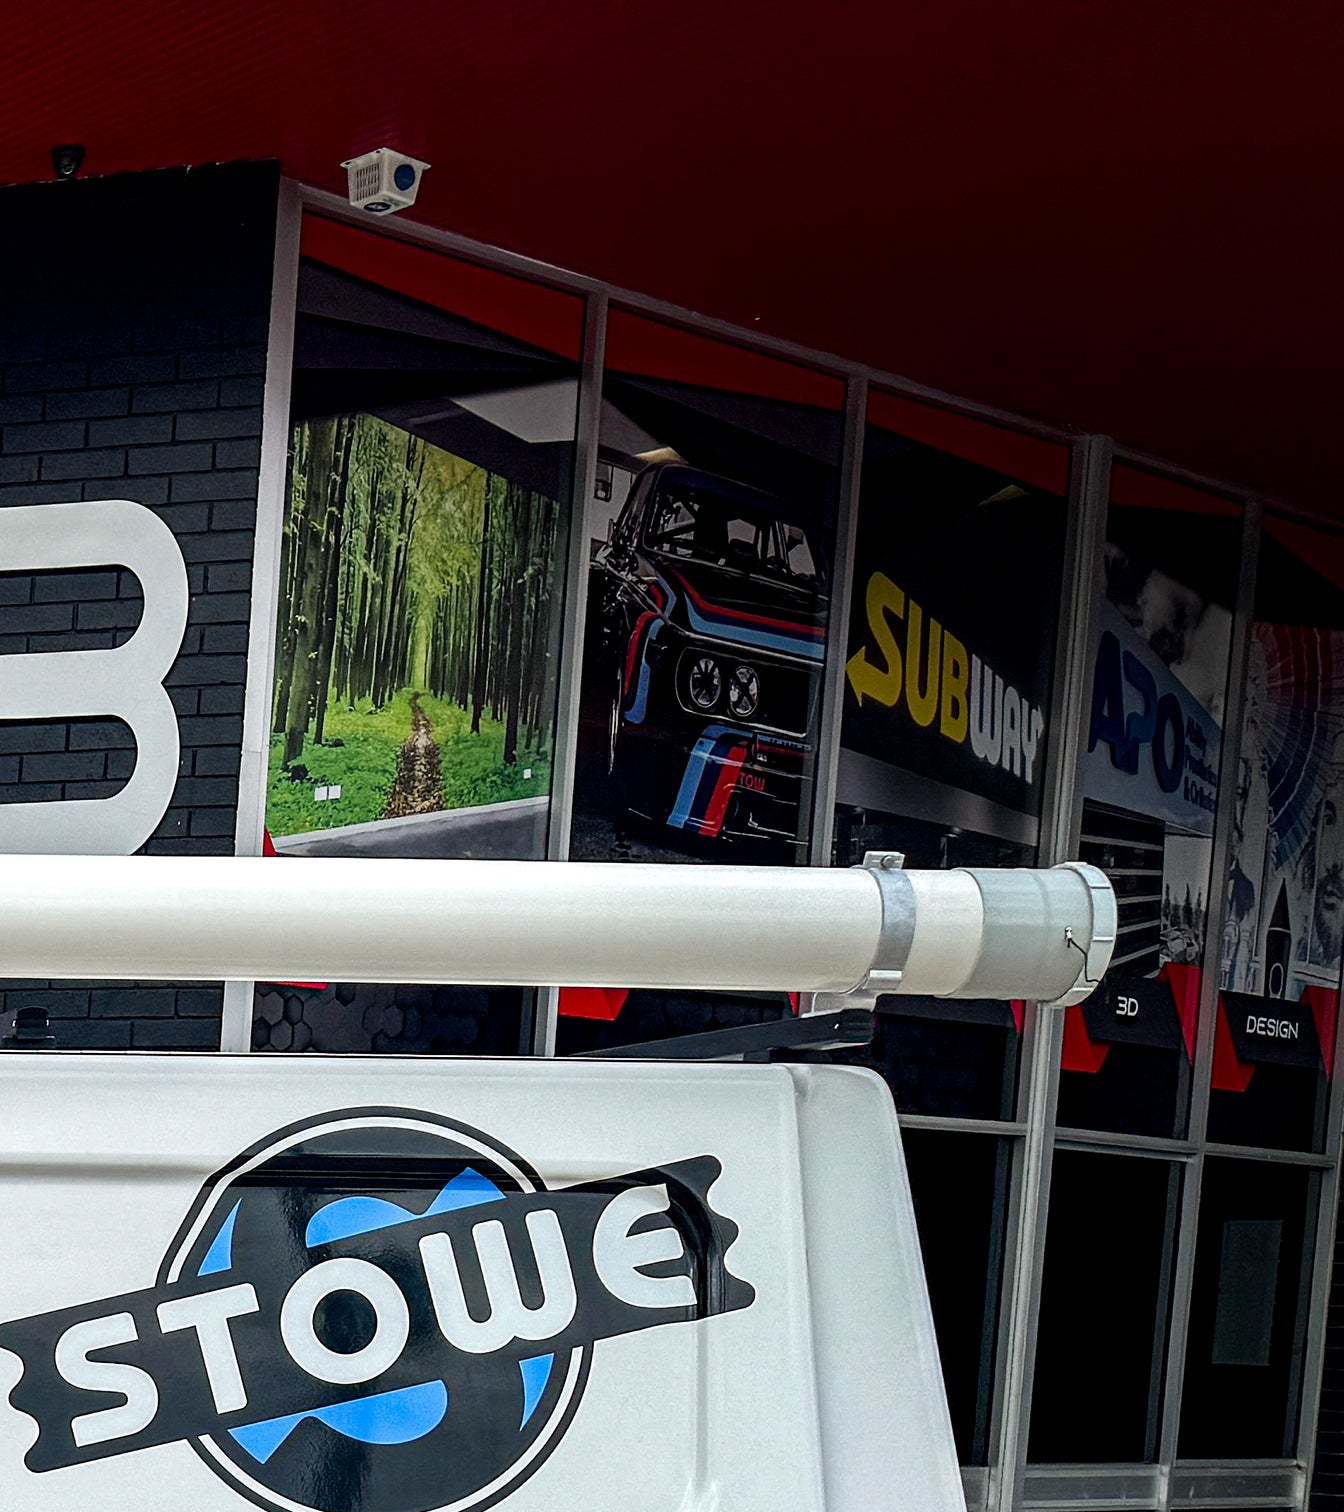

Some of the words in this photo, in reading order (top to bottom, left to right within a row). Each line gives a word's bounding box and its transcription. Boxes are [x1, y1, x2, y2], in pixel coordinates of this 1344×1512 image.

[846, 571, 1044, 785] SUBWAY
[739, 771, 766, 791] TOW
[1115, 995, 1139, 1017] 3D
[1245, 1014, 1299, 1040] DESIGN
[54, 1183, 698, 1448] STOWE
